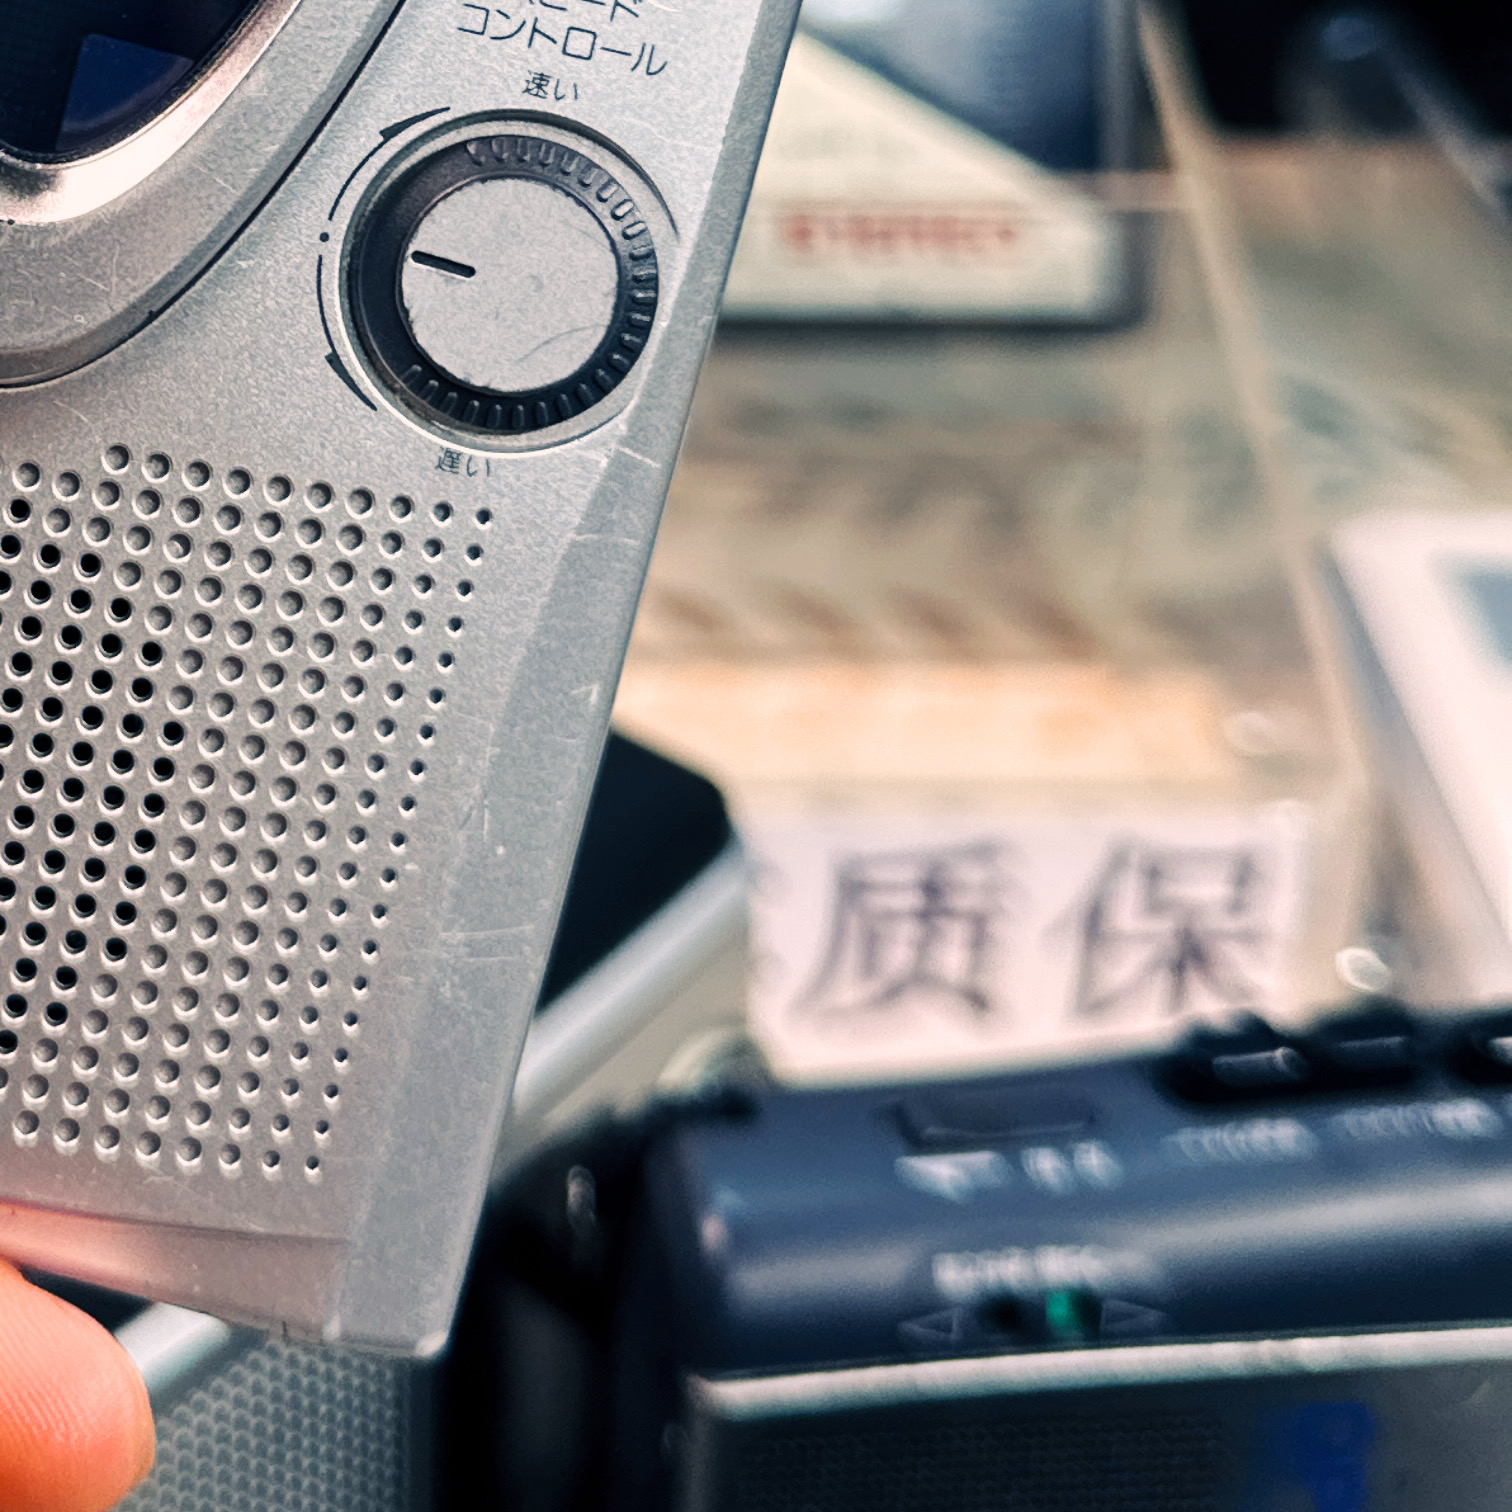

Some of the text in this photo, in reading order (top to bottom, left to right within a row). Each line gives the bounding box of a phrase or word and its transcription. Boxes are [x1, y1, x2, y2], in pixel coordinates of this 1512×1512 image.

[456, 2, 668, 76] コントロール
[521, 69, 579, 102] 速い
